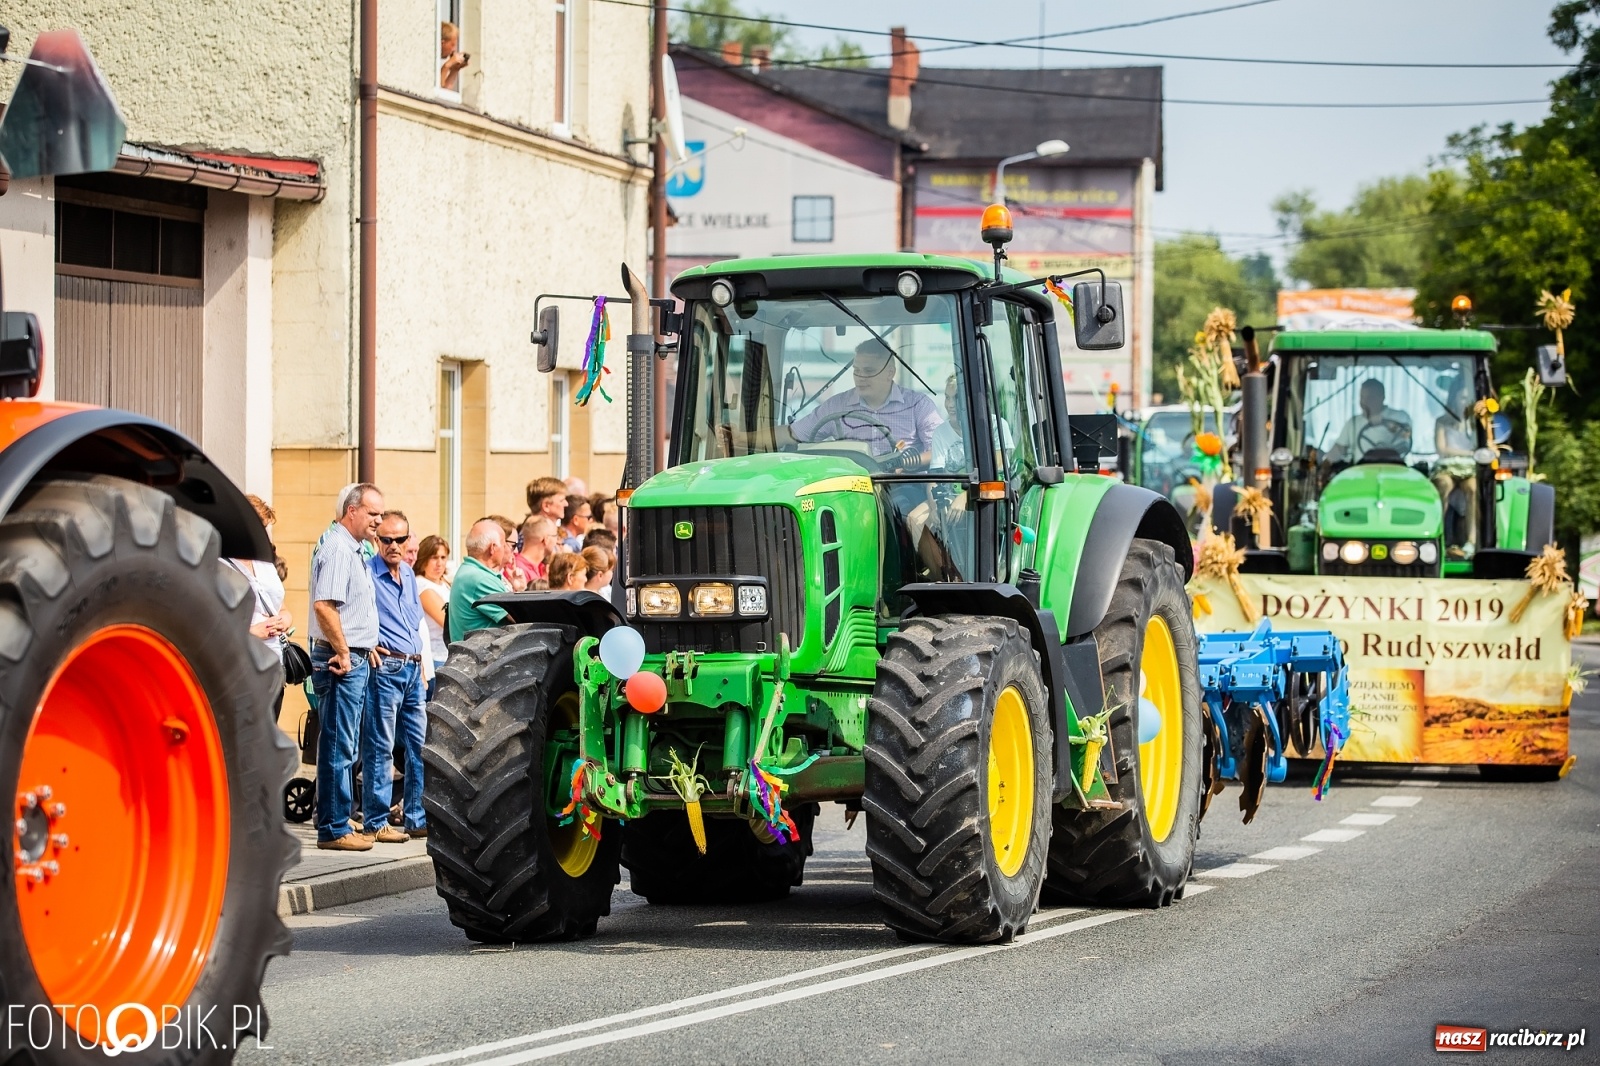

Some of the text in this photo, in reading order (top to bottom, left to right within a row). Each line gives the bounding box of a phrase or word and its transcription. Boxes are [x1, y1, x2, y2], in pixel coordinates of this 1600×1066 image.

[700, 211, 771, 230] WIELKIE
[1261, 589, 1505, 622] DOŻYNKI 2019
[1361, 632, 1543, 665] Rudyszwałd
[1351, 681, 1417, 691] ZIĘKUJEMY
